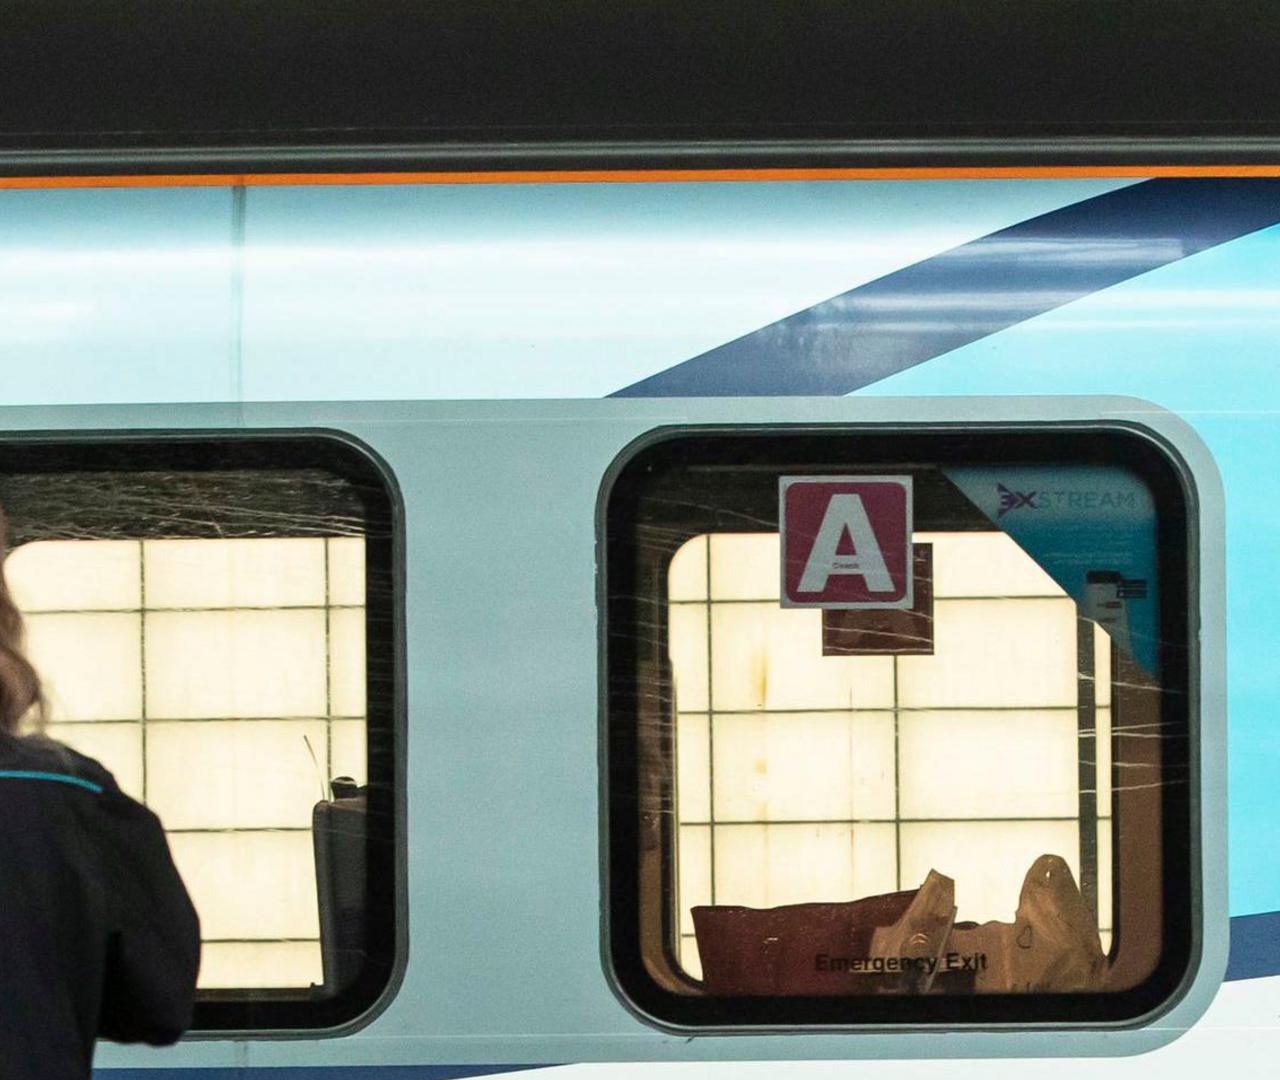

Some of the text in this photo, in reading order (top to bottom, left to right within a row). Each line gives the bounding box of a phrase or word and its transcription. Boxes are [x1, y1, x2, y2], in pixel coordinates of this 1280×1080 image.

[797, 493, 895, 593] A
[814, 952, 989, 975] Emergency Exit
